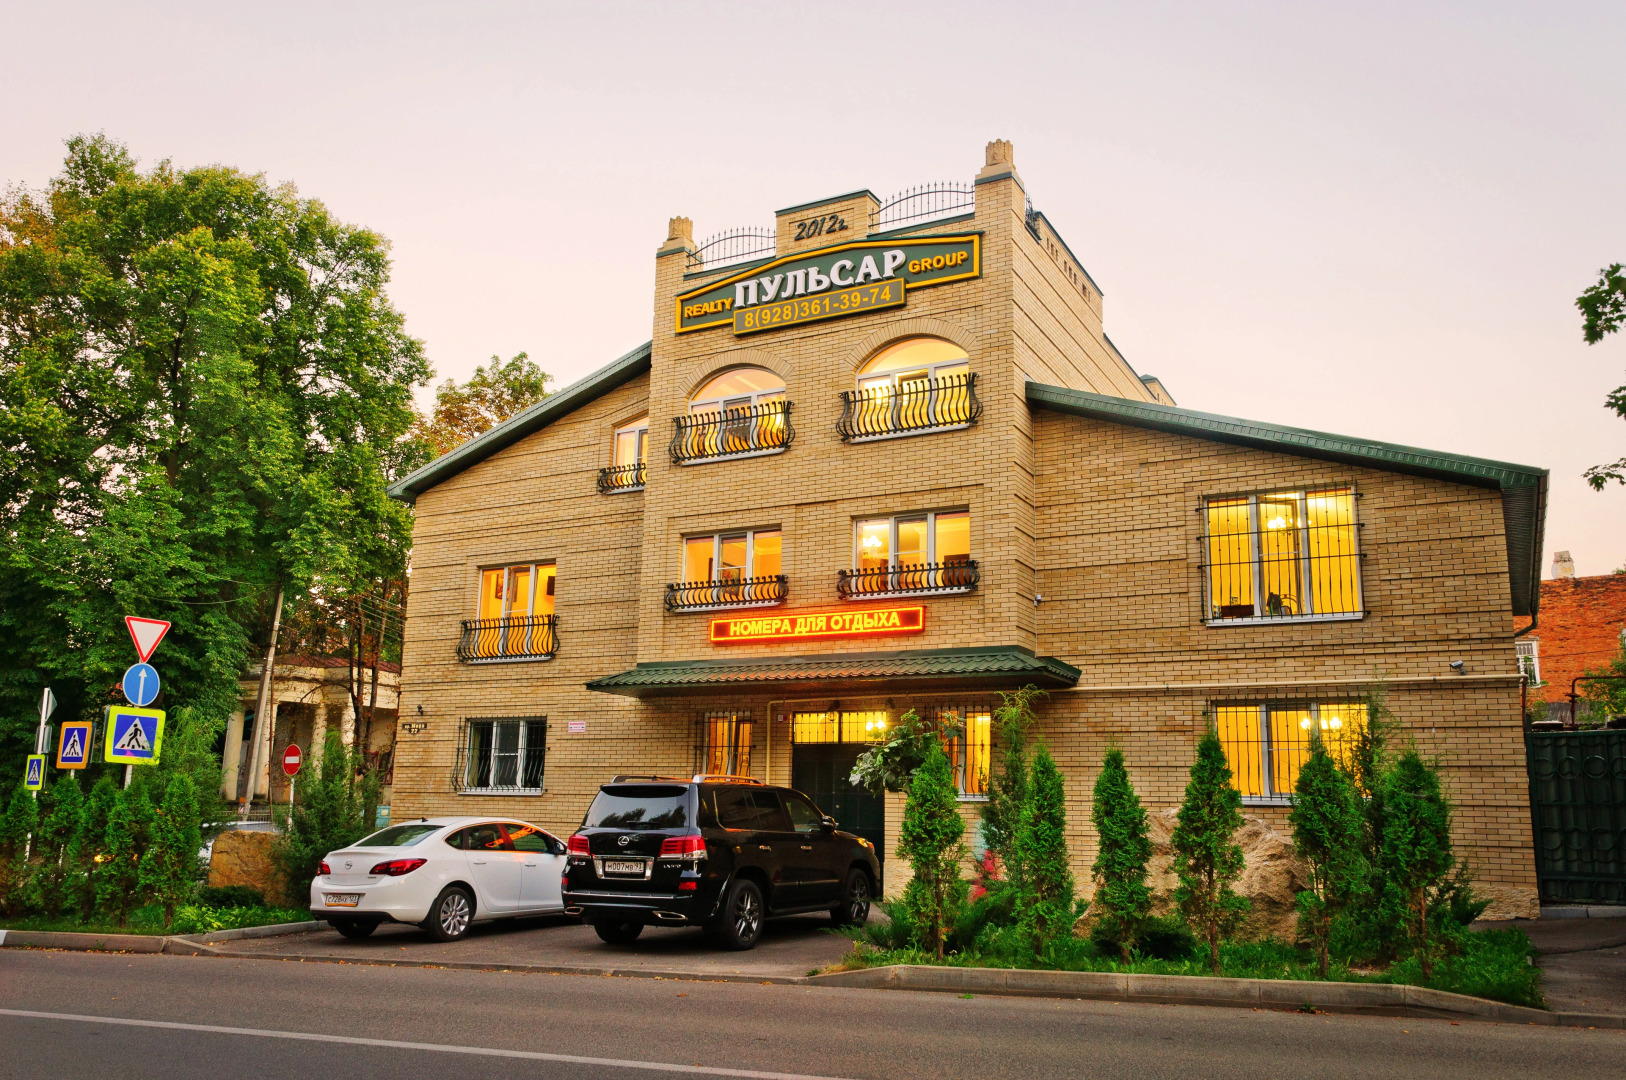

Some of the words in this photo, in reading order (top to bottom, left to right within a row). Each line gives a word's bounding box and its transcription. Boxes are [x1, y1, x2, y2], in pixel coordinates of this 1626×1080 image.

[908, 250, 968, 274] GROUP
[734, 249, 907, 308] ПУЛЬСАР
[684, 297, 733, 318] REALTY
[744, 285, 892, 328] 8(928)361-39-74
[730, 619, 792, 636] НОМЕРА
[795, 617, 826, 635] ДЛЯ
[830, 612, 900, 631] ОТДЫХА
